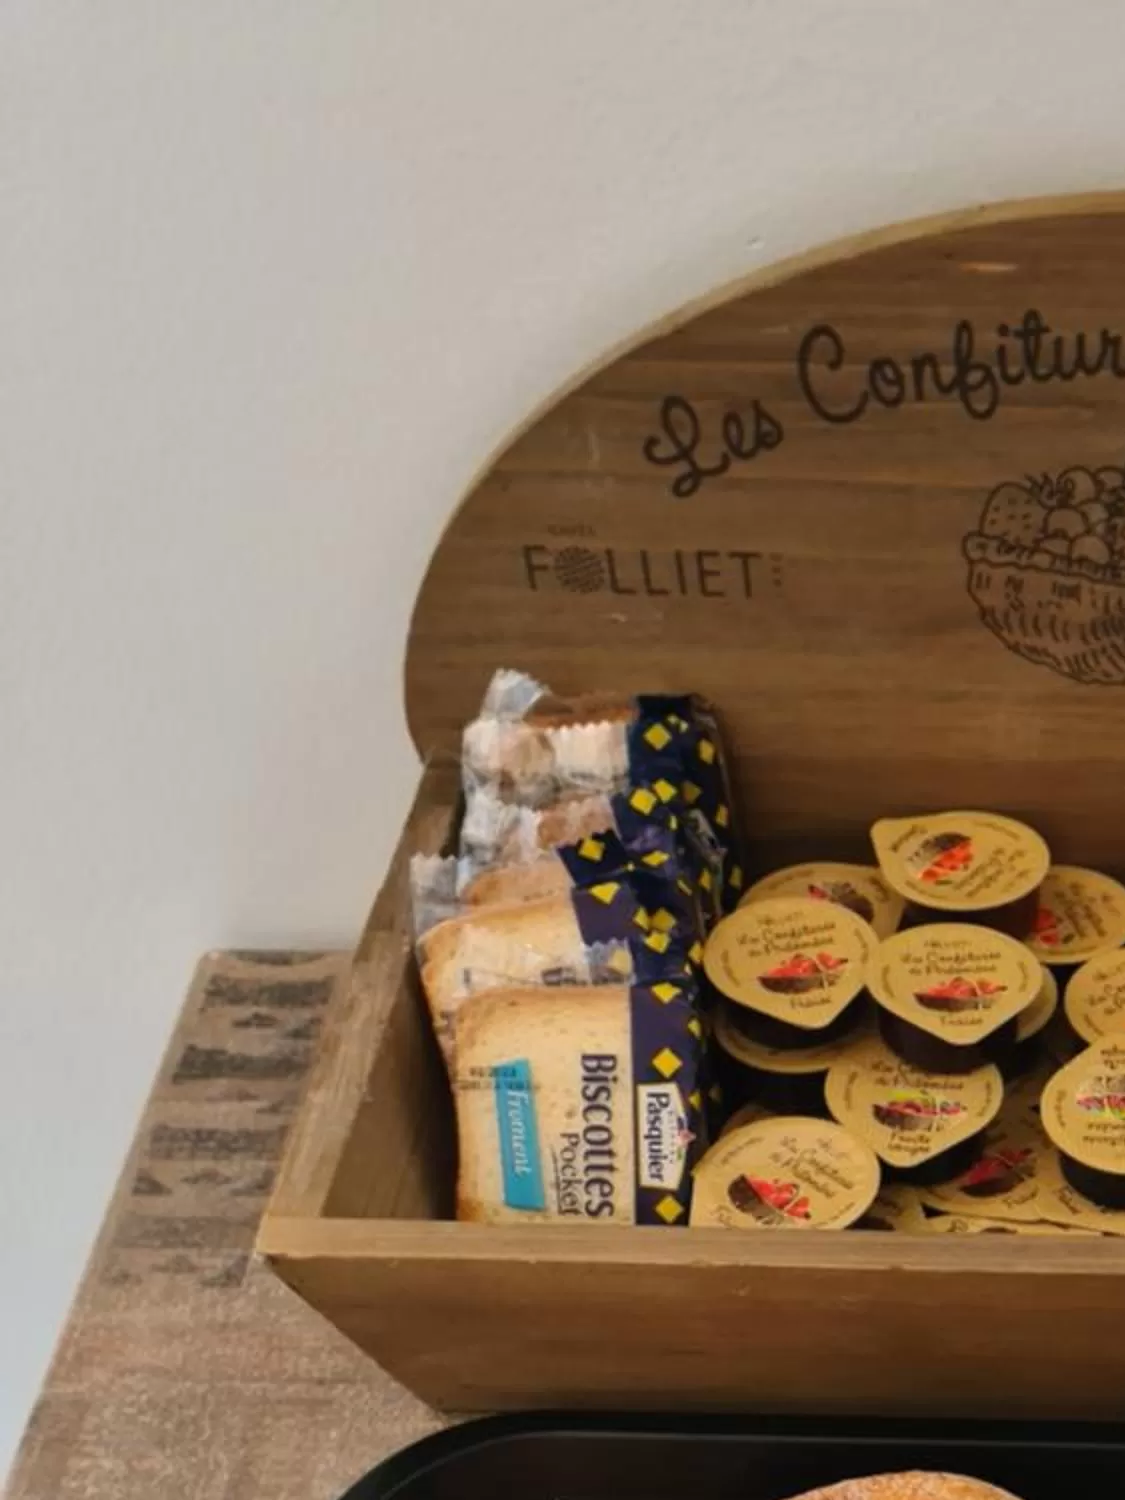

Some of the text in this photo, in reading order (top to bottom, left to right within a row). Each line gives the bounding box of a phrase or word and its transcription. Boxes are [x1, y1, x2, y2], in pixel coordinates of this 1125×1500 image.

[644, 395, 784, 498] Les
[557, 1131, 584, 1216] Pocket
[580, 1053, 620, 1218] Biscottes
[642, 1091, 671, 1183] Pasquier
